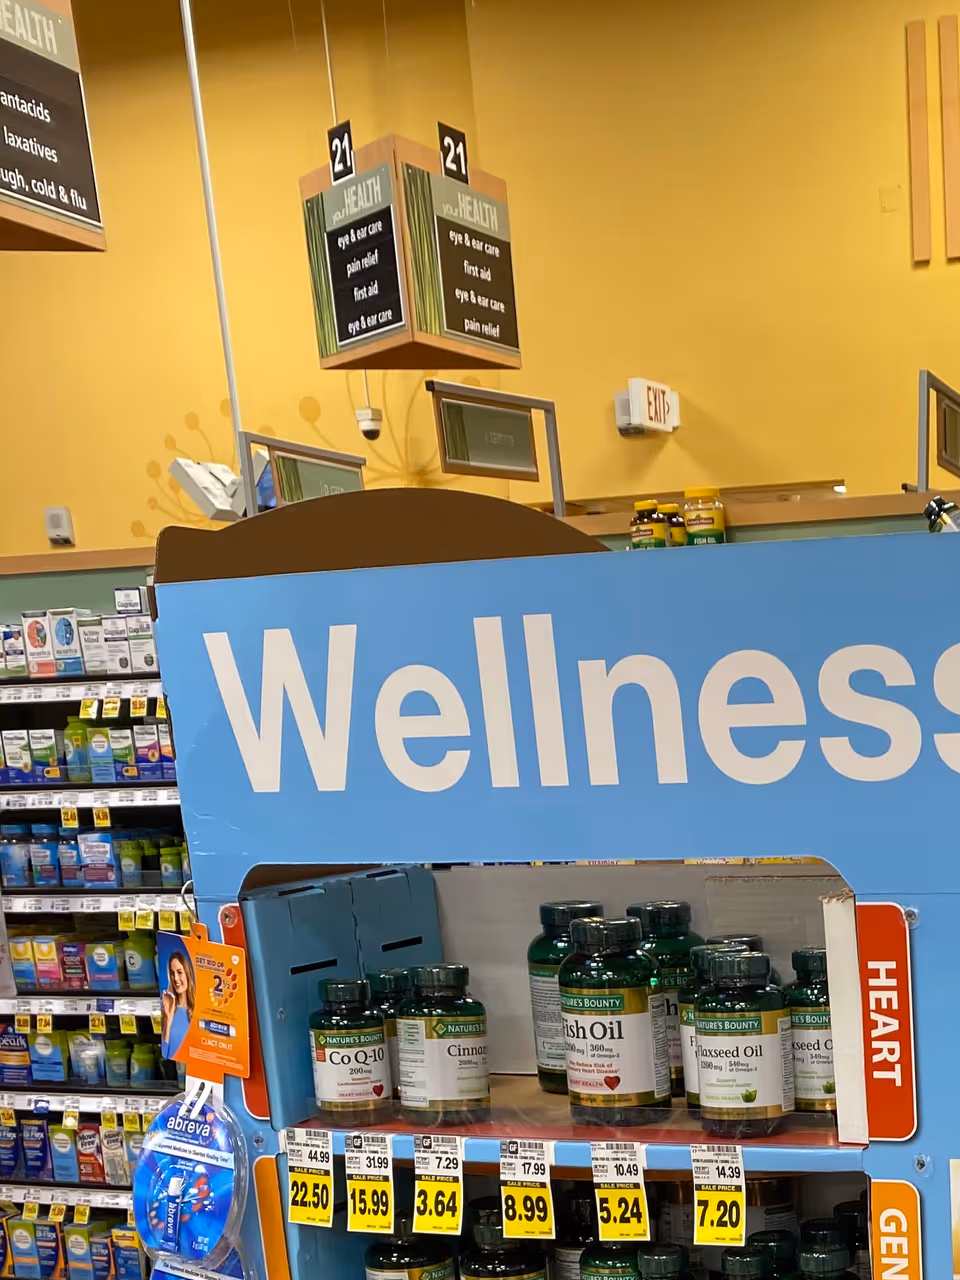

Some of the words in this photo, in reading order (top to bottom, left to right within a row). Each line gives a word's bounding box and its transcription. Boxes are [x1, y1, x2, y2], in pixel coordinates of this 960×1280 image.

[4, 126, 58, 163] laxatives
[331, 132, 351, 173] 21
[443, 136, 467, 175] 21
[31, 179, 57, 199] cold
[59, 186, 69, 203] &
[70, 189, 87, 210] flu
[344, 175, 382, 216] HEALTH
[458, 192, 498, 232] HEALTH
[337, 233, 349, 250] eye
[350, 231, 357, 242] &
[357, 226, 367, 240] ear
[368, 220, 383, 235] care
[450, 230, 463, 246] eye
[464, 235, 471, 247] &
[471, 238, 484, 251] ear
[485, 243, 500, 258] care
[347, 260, 361, 278] pain
[362, 249, 379, 269] relief
[464, 260, 479, 278] first
[480, 267, 491, 282] aid
[354, 287, 367, 302] first
[367, 280, 378, 295] aid
[455, 287, 469, 303] eye
[470, 292, 477, 304] &
[477, 295, 490, 308] ear
[490, 300, 505, 314] care
[348, 318, 359, 335] eye
[360, 315, 367, 328] &
[367, 312, 377, 325] ear
[378, 308, 392, 321] care
[464, 318, 481, 334] pain
[481, 321, 500, 338] relief
[647, 385, 667, 424] EXIT
[584, 998, 620, 1008] BOUNTY
[448, 1023, 480, 1033] NATURE'S
[590, 1020, 624, 1040] Oil
[725, 1021, 759, 1030] BOUNTY
[867, 960, 902, 1087] HEART
[327, 1034, 359, 1044] NATURE'S
[744, 1045, 763, 1057] Oil
[329, 1051, 351, 1065] Co
[354, 1047, 385, 1066] Q-10
[167, 1116, 211, 1137] abreva
[291, 1180, 330, 1210] 22.50
[350, 1188, 389, 1217] 15.99
[416, 1189, 458, 1218] 3.64
[504, 1194, 548, 1222] 8.99
[167, 1201, 177, 1235] abreva
[599, 1197, 642, 1224] 5.24
[697, 1200, 741, 1229] 7.20
